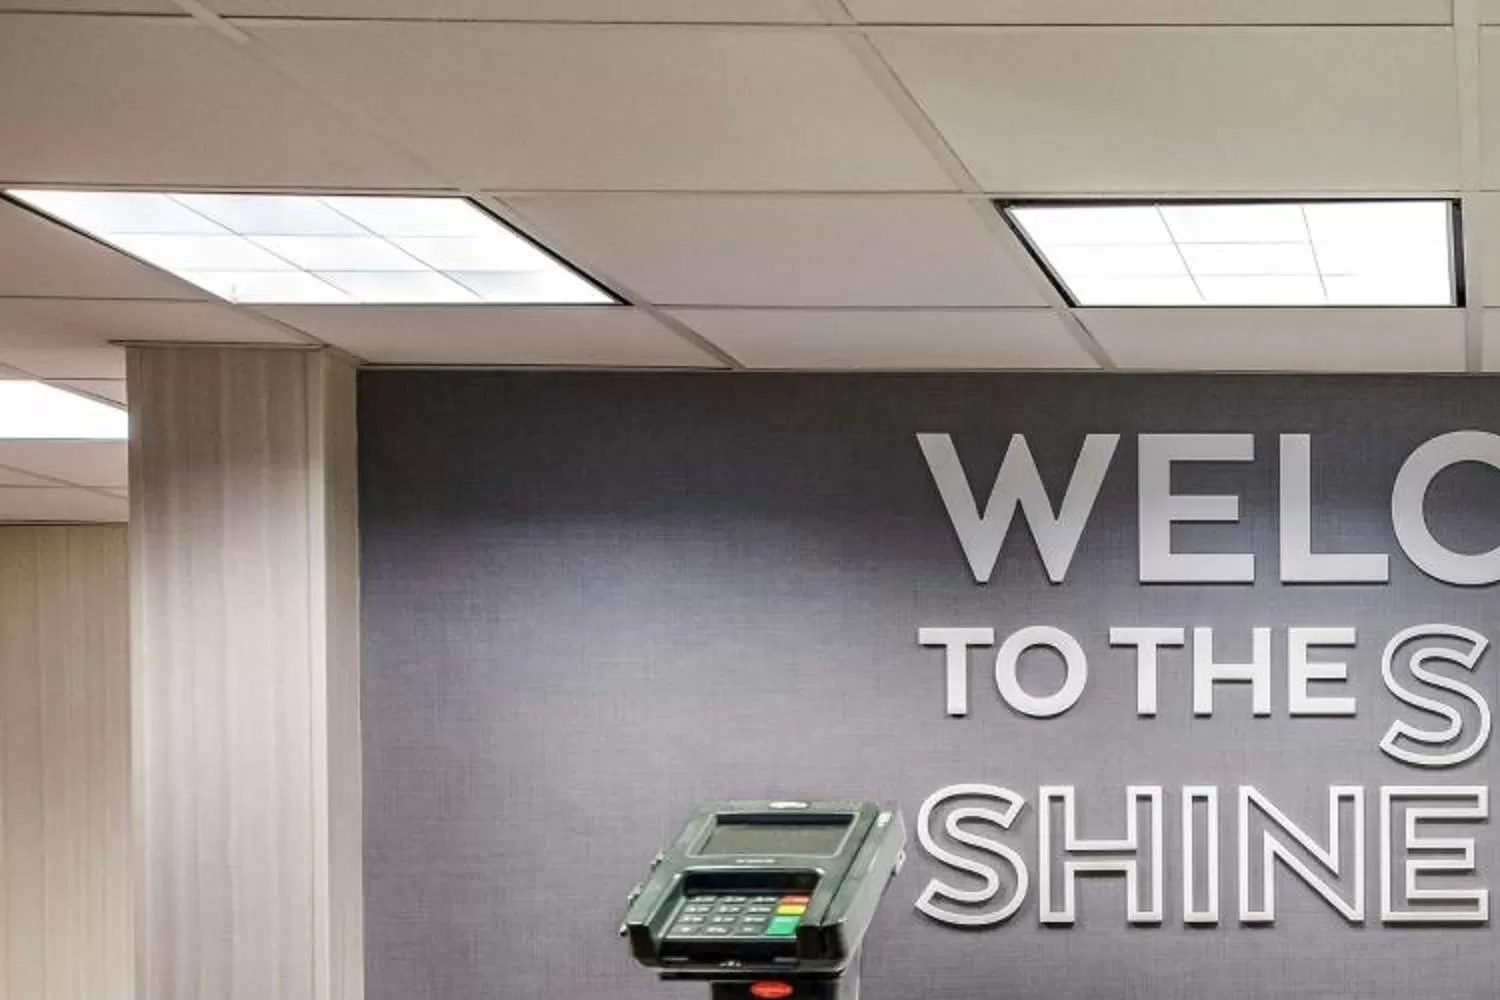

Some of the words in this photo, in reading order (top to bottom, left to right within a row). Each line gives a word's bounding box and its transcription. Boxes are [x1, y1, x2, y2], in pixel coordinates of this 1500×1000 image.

[918, 626, 1088, 716] TO
[1110, 626, 1357, 714] THE
[914, 784, 1490, 925] SHINE
